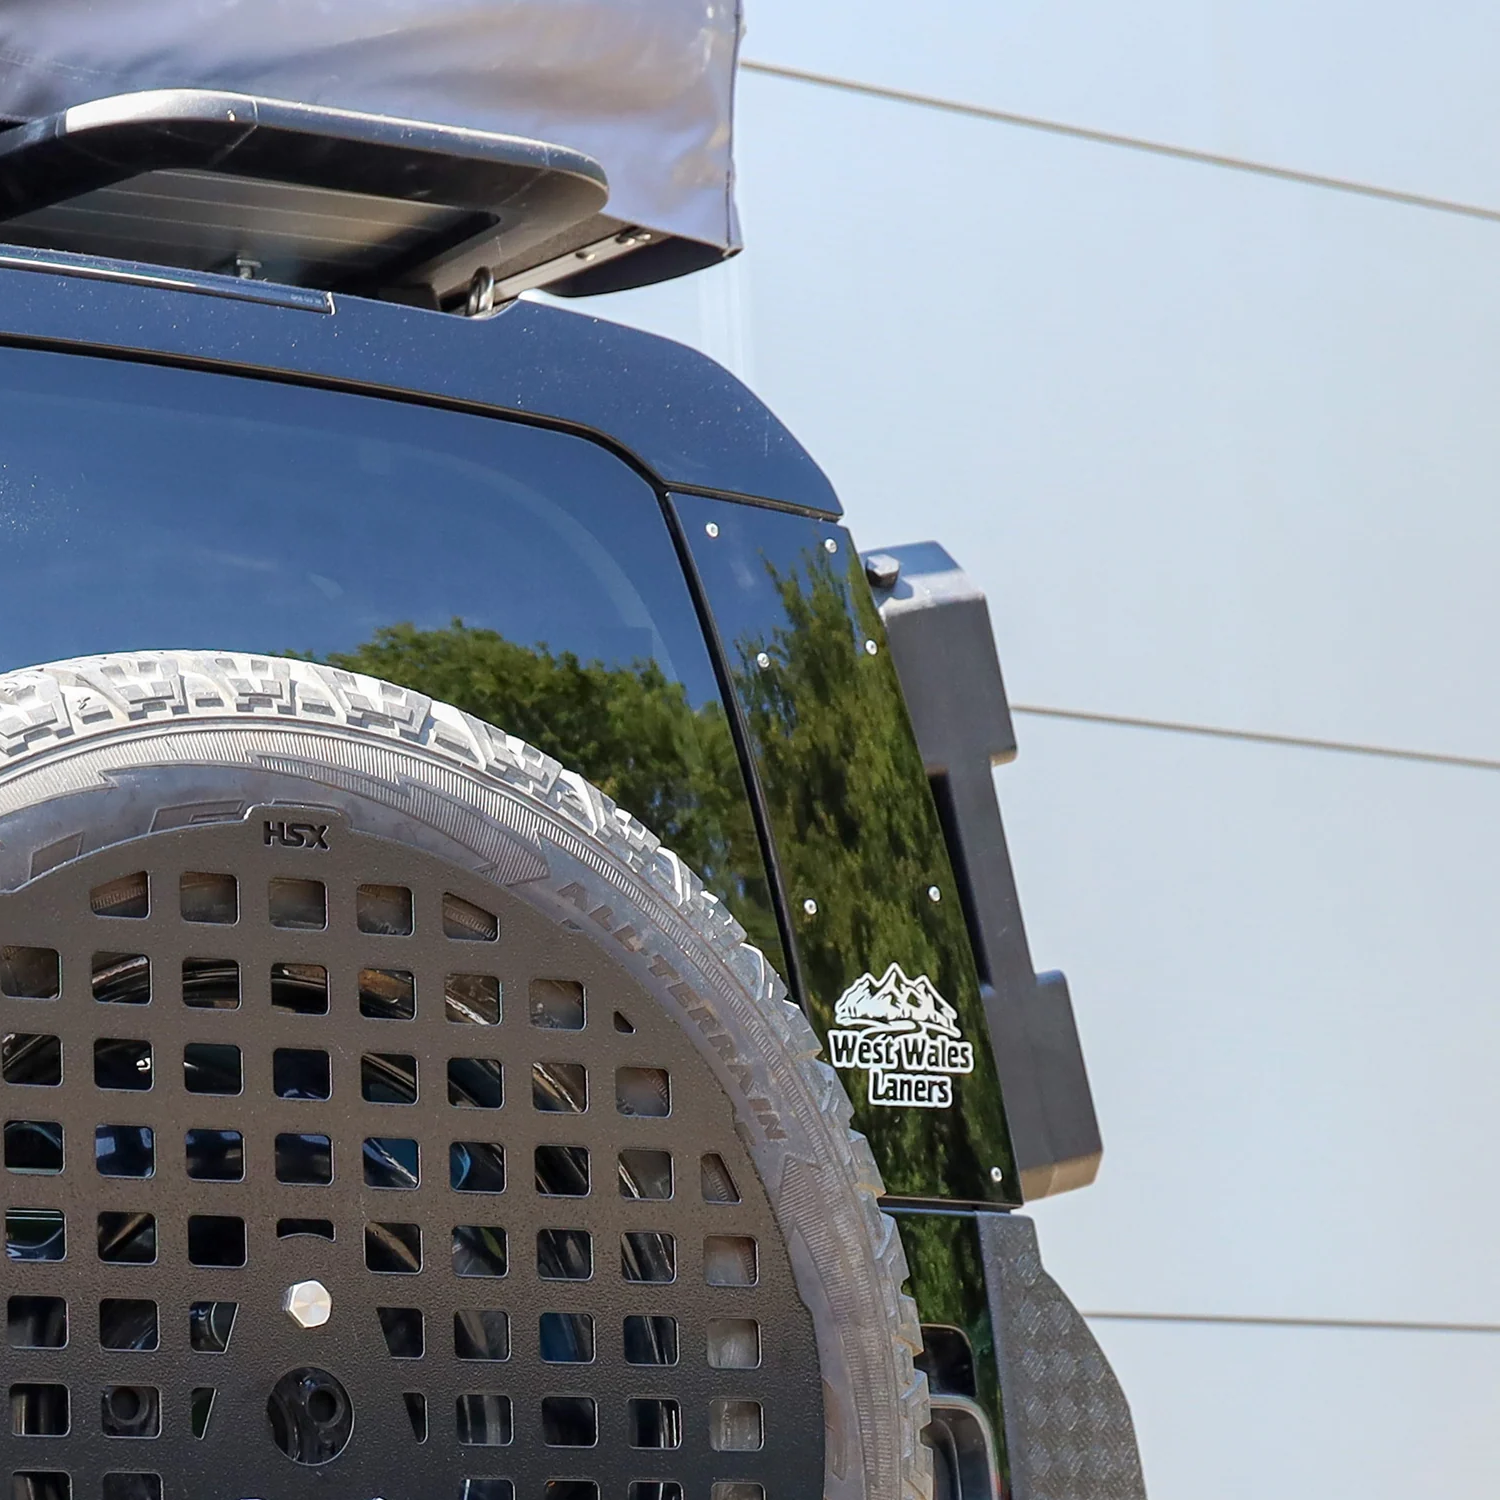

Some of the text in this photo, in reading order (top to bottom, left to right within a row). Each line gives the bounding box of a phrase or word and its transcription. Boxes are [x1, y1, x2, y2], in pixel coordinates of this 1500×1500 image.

[263, 821, 331, 850] HSX
[831, 1034, 971, 1069] West Wales
[872, 1070, 950, 1103] Laners
